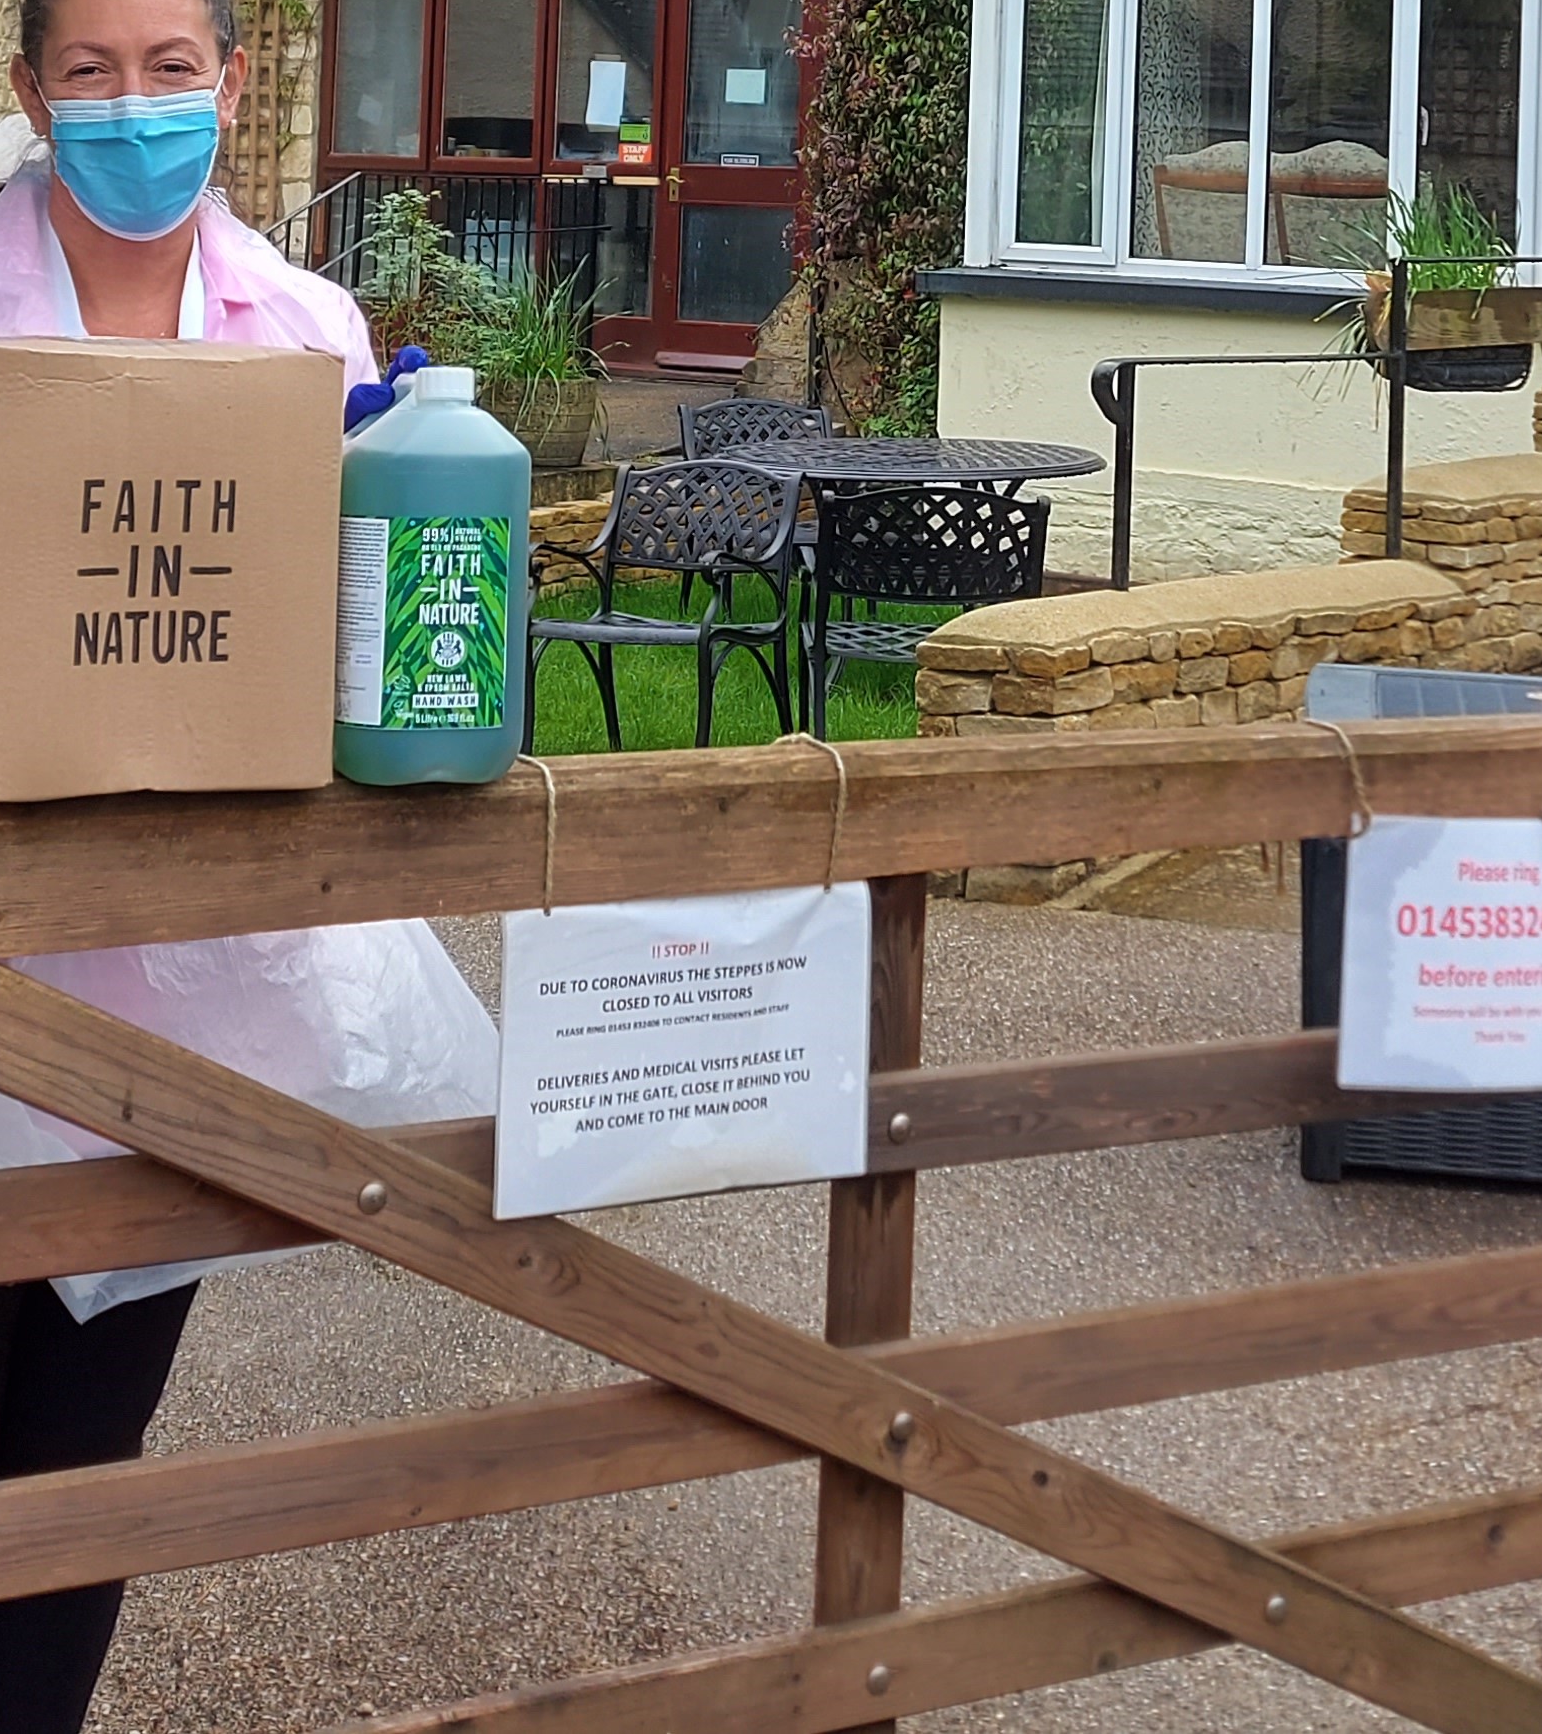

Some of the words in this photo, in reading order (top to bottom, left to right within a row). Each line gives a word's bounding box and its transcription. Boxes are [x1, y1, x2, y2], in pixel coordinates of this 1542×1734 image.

[81, 479, 236, 533] FAITH
[422, 527, 449, 542] 99%
[127, 545, 182, 598] IN
[421, 553, 481, 576] FAITH
[439, 578, 462, 600] IN
[419, 603, 479, 625] NATURE
[73, 610, 231, 666] NATURE
[415, 697, 442, 706] HAND
[447, 696, 475, 706] WASH
[1459, 862, 1509, 882] Please
[1513, 862, 1540, 886] ring
[663, 943, 697, 958] STOP
[540, 981, 566, 996] DUE
[570, 979, 588, 994] TO
[591, 970, 684, 992] CORONAVIRUS
[687, 967, 711, 982] THE
[714, 963, 763, 980] STEPPES
[765, 960, 775, 974] IS
[776, 955, 807, 971] NOW
[1418, 962, 1488, 987] before
[602, 996, 650, 1013] CLOSED
[654, 993, 670, 1008] TO
[673, 990, 695, 1006] ALL
[698, 985, 754, 1003] VISITORS
[556, 1027, 585, 1038] PLEASE
[586, 1024, 607, 1035] RING
[662, 1016, 673, 1027] TO
[674, 1013, 711, 1026] CONTACT
[712, 1008, 752, 1022] RESIDENTS
[537, 1071, 609, 1091] DELIVERIES
[611, 1067, 640, 1083] AND
[643, 1059, 698, 1080] MEDICAL
[701, 1055, 739, 1072] VISITS
[741, 1049, 782, 1068] PLEASE
[784, 1047, 805, 1062] LET
[529, 1095, 596, 1115] YOURSELF
[599, 1093, 613, 1107] IN
[615, 1089, 640, 1105] THE
[642, 1084, 678, 1102] GATE,
[681, 1080, 720, 1097] CLOSE
[722, 1078, 734, 1093] IT
[736, 1072, 781, 1091] BEHIND
[783, 1068, 811, 1085] YOU
[575, 1117, 604, 1133] AND
[607, 1111, 645, 1130] COME
[648, 1108, 665, 1124] TO
[667, 1105, 691, 1121] THE
[694, 1101, 729, 1118] MAIN
[732, 1096, 768, 1113] DOOR
